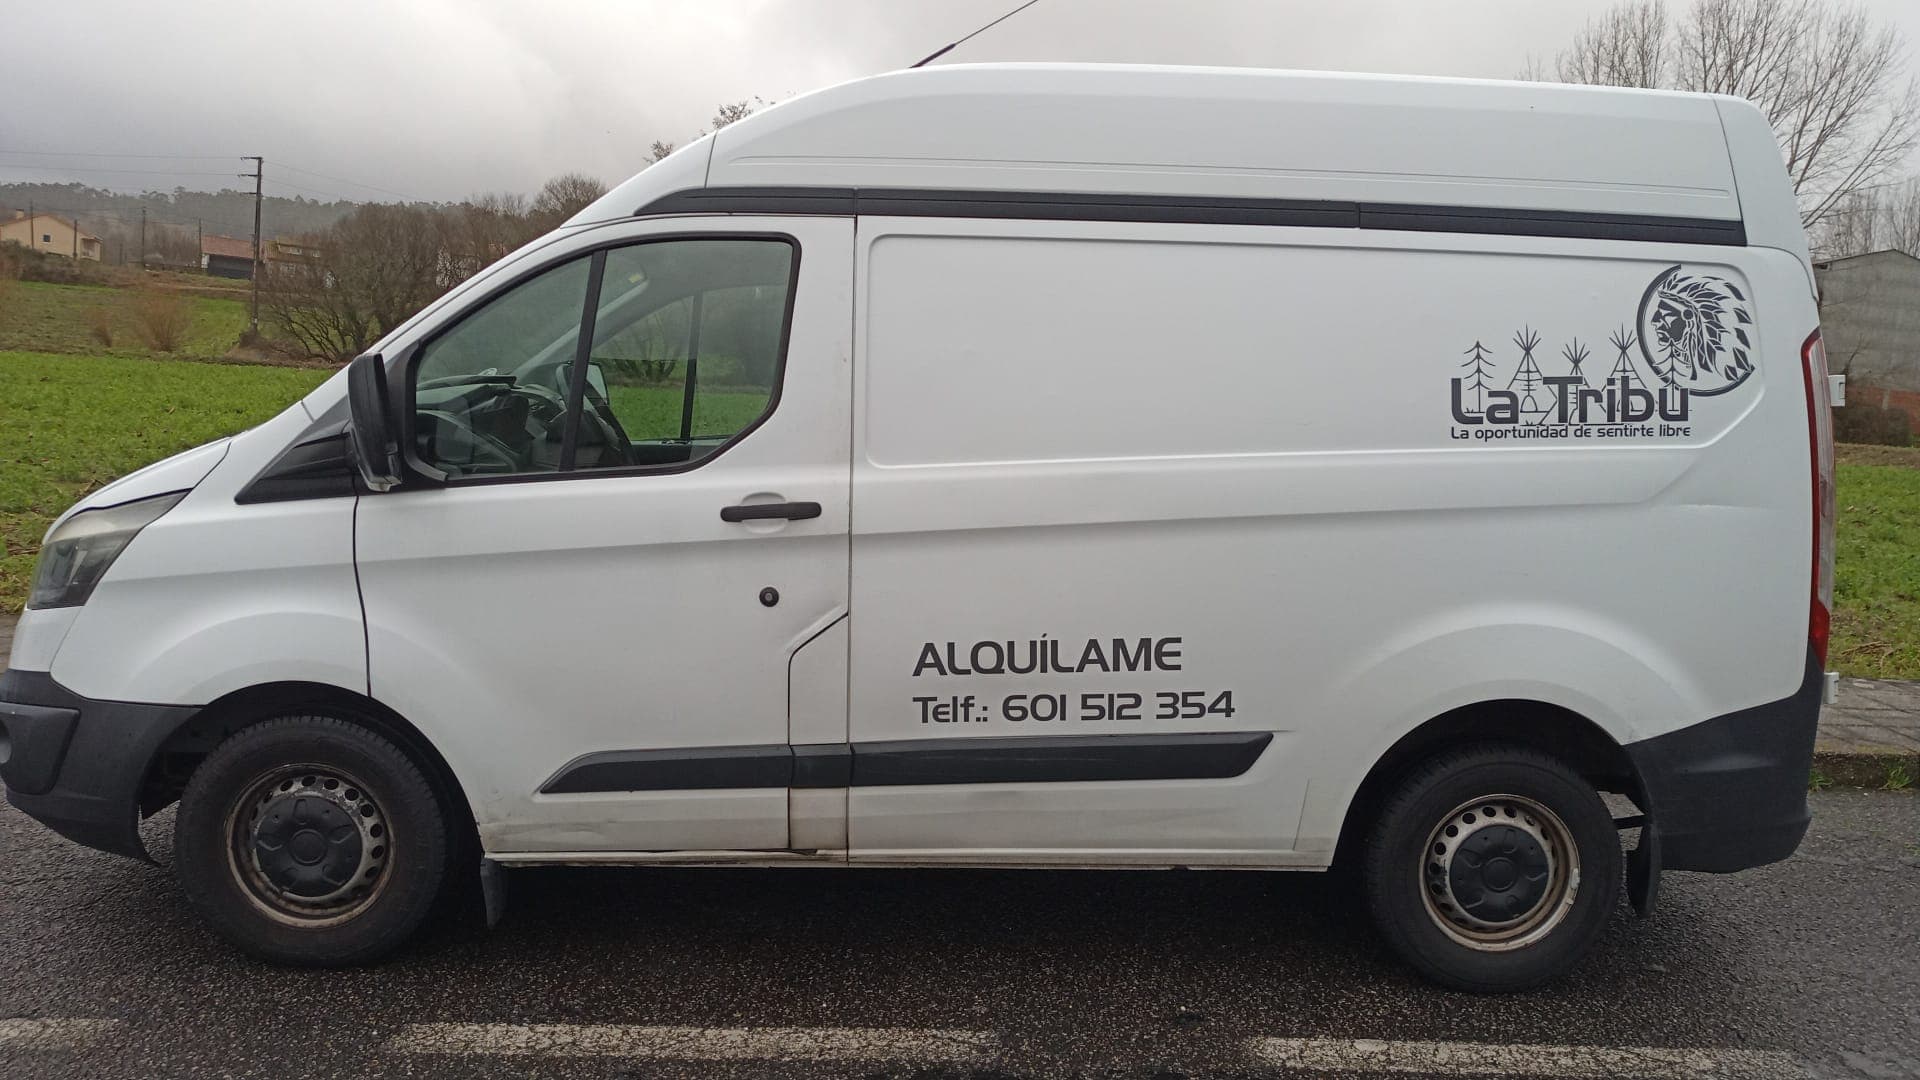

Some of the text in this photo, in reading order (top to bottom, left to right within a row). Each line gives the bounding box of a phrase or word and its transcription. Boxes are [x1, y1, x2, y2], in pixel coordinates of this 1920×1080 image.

[1451, 375, 1689, 425] La Tribu
[1451, 423, 1691, 442] La oportunidad de sentirte libre
[912, 633, 1182, 677] ALQUÍLAME
[912, 691, 1235, 723] Telf.: 601 512 354
